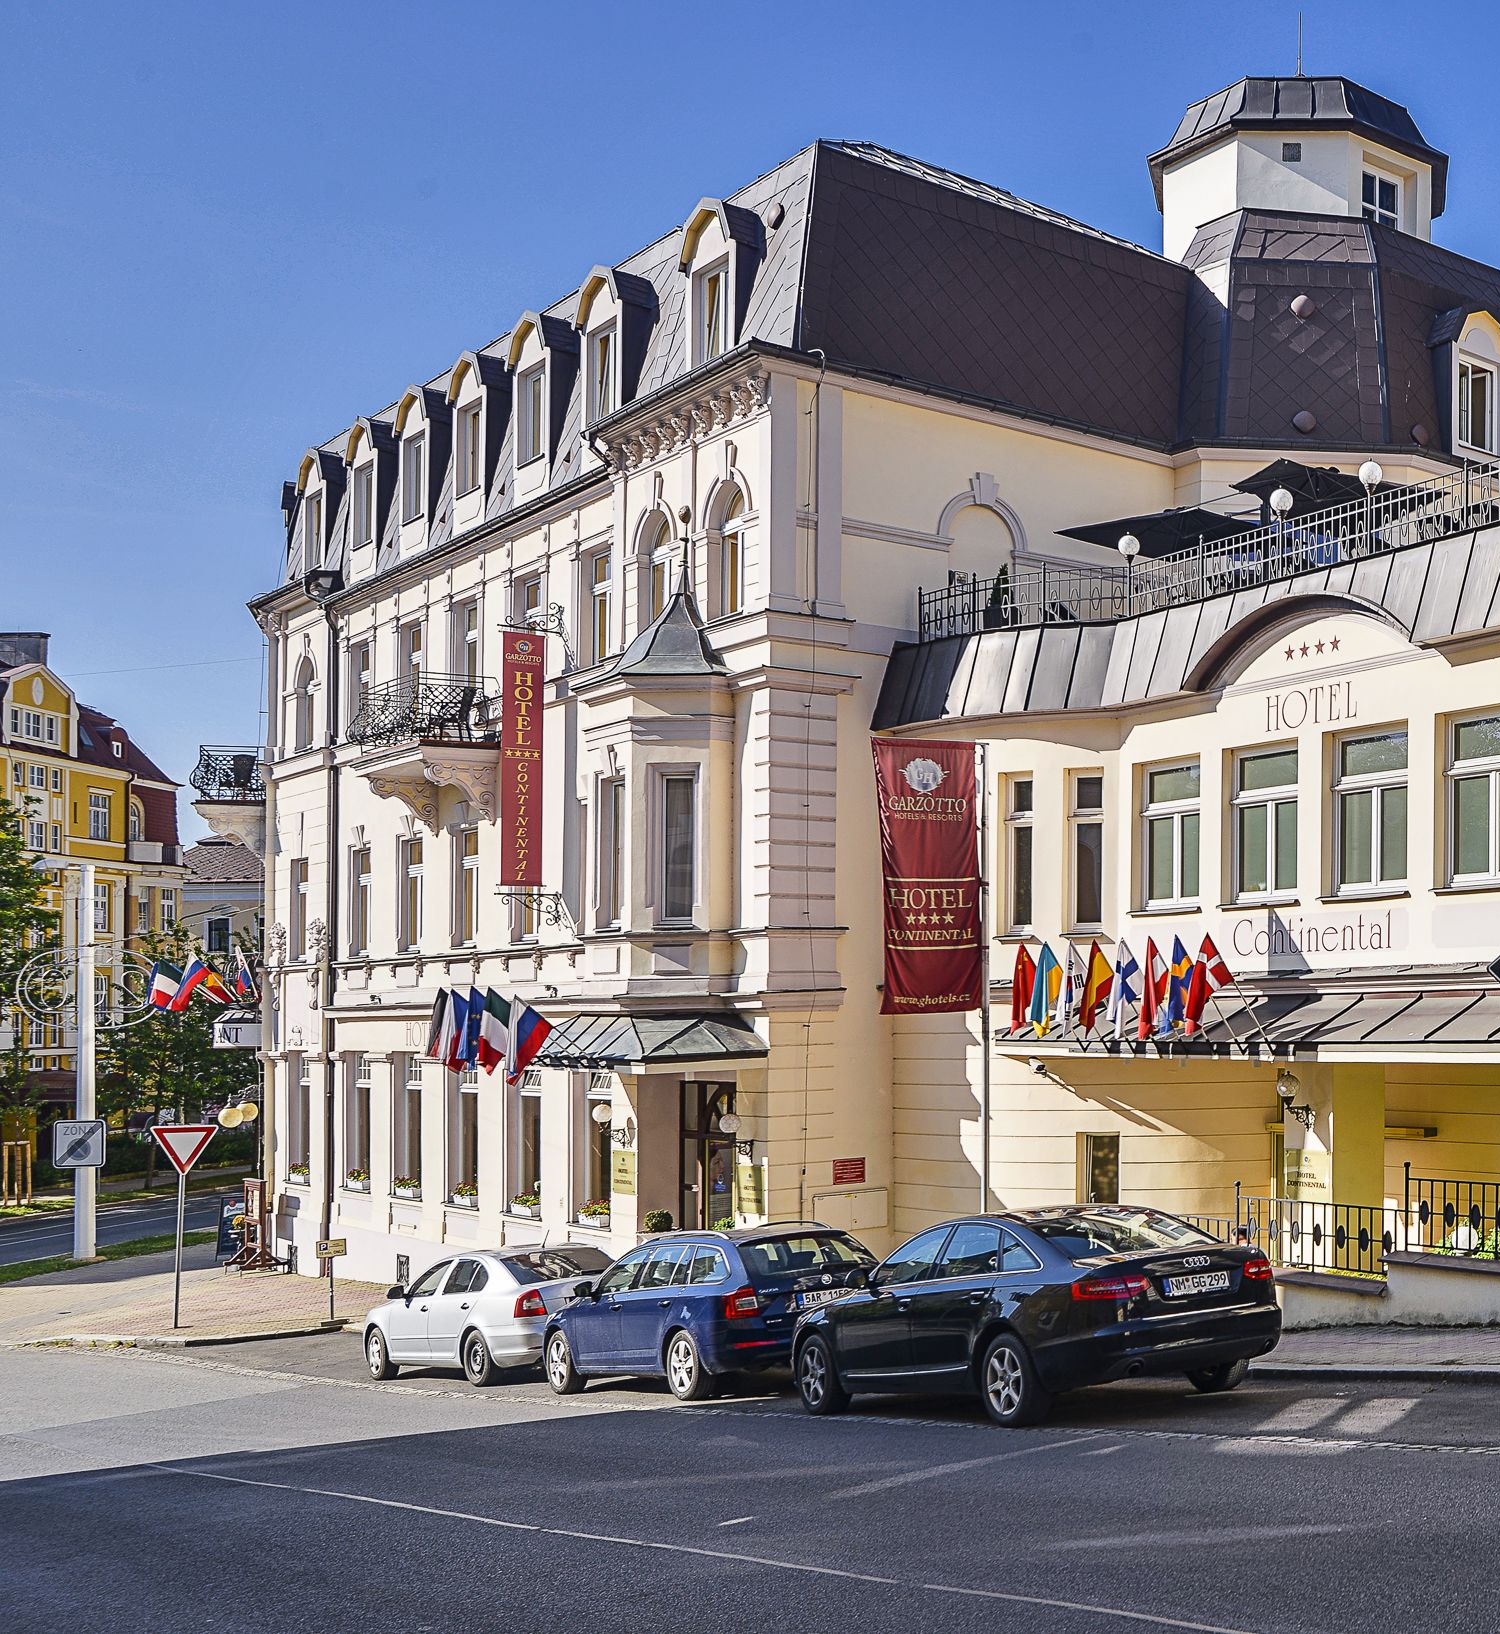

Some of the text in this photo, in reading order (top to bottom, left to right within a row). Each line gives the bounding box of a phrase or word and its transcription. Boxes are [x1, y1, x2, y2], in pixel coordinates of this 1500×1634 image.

[505, 652, 542, 662] GARZOTTO
[514, 671, 534, 746] HOTEL
[1265, 681, 1357, 732] HOTEL
[888, 795, 967, 813] GARZOTTO
[515, 762, 529, 881] CONTINENTAL
[894, 812, 920, 820] HOTELS
[928, 813, 963, 822] RESORTS
[889, 887, 973, 909] HOTEL
[887, 928, 975, 941] CONTINENTAL
[1233, 910, 1393, 957] Continental
[894, 993, 971, 1007] www.ghotels.cz
[405, 1021, 433, 1047] HOT
[1296, 1171, 1317, 1179] HOTEL
[1286, 1180, 1326, 1189] CONTINENTAL
[1171, 1277, 1187, 1292] NM
[1191, 1275, 1207, 1288] GG
[1207, 1272, 1227, 1287] 299
[805, 1293, 822, 1304] 5AR
